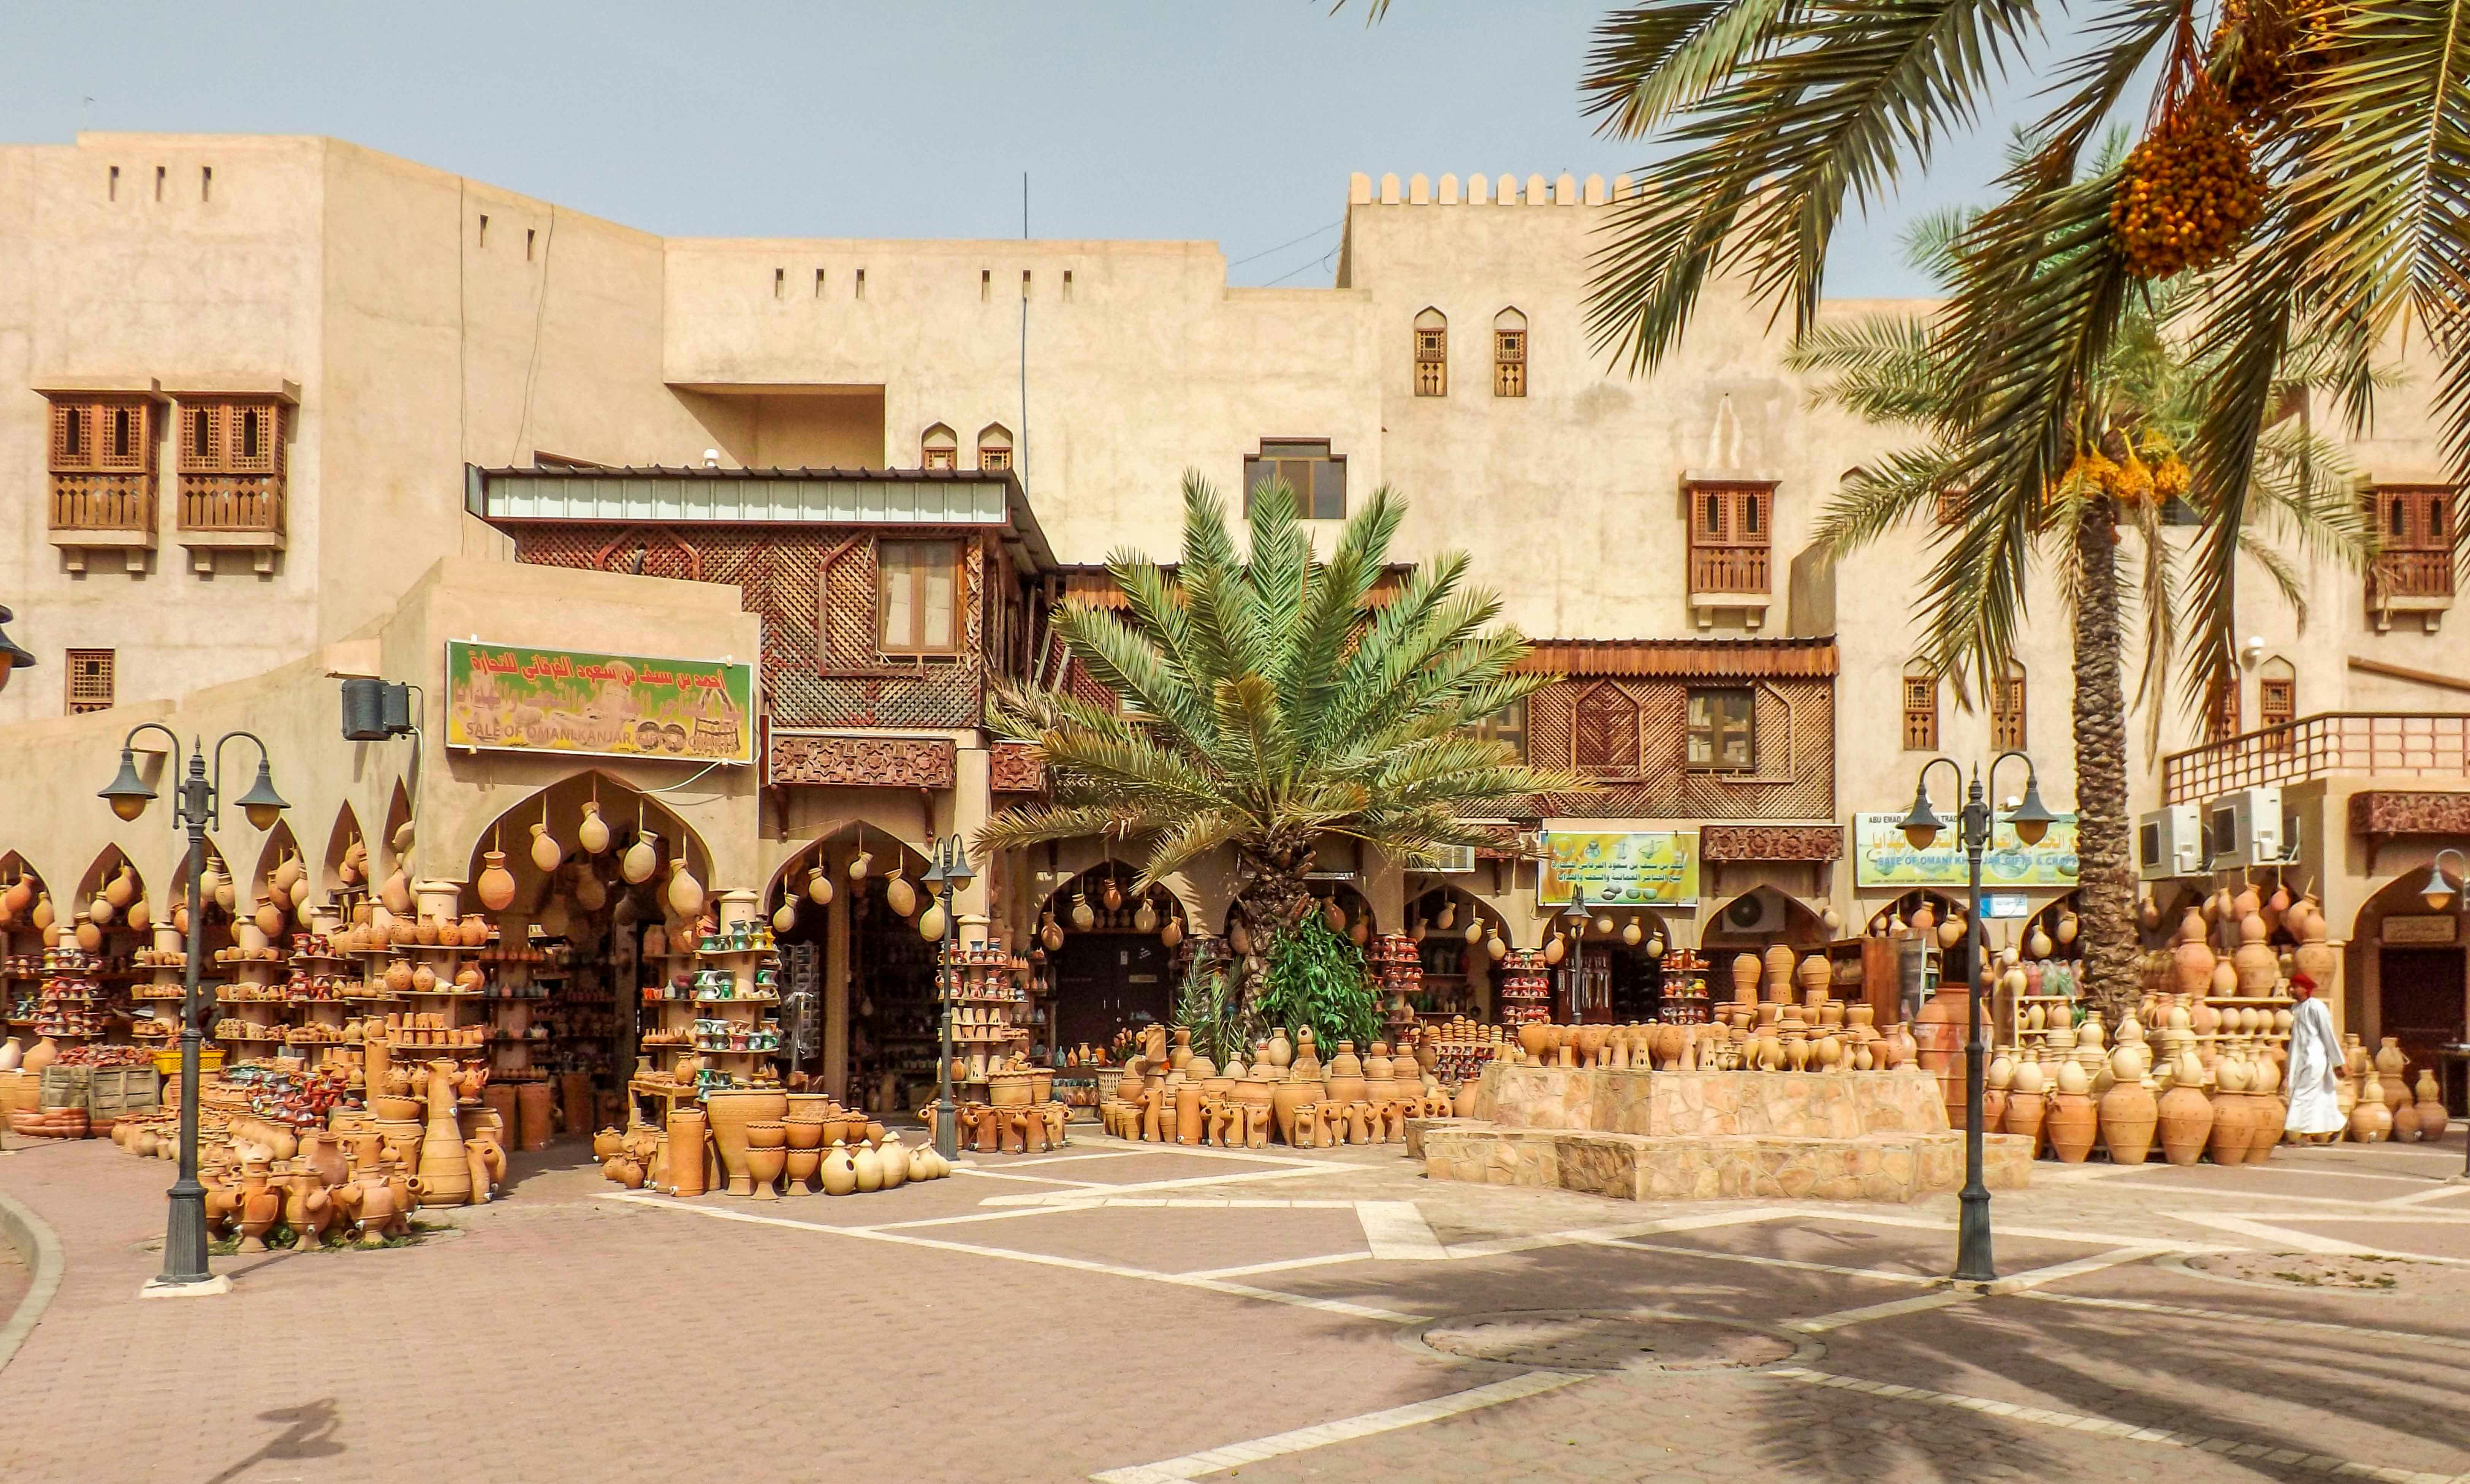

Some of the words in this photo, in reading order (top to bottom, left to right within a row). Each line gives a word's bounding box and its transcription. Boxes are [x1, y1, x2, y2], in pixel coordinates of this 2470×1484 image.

[469, 650, 518, 675] للتجارة
[521, 654, 574, 683] الفرقاني
[576, 664, 617, 683] سعود
[621, 669, 635, 686] بن
[639, 664, 673, 686] سيف
[677, 673, 691, 690] بن
[694, 669, 726, 689] أحمد
[467, 722, 500, 737] SALE
[504, 725, 522, 737] OF
[1878, 856, 1900, 865] SALE
[1921, 856, 1952, 864] OMANI
[1955, 856, 2000, 864] KHJAR
